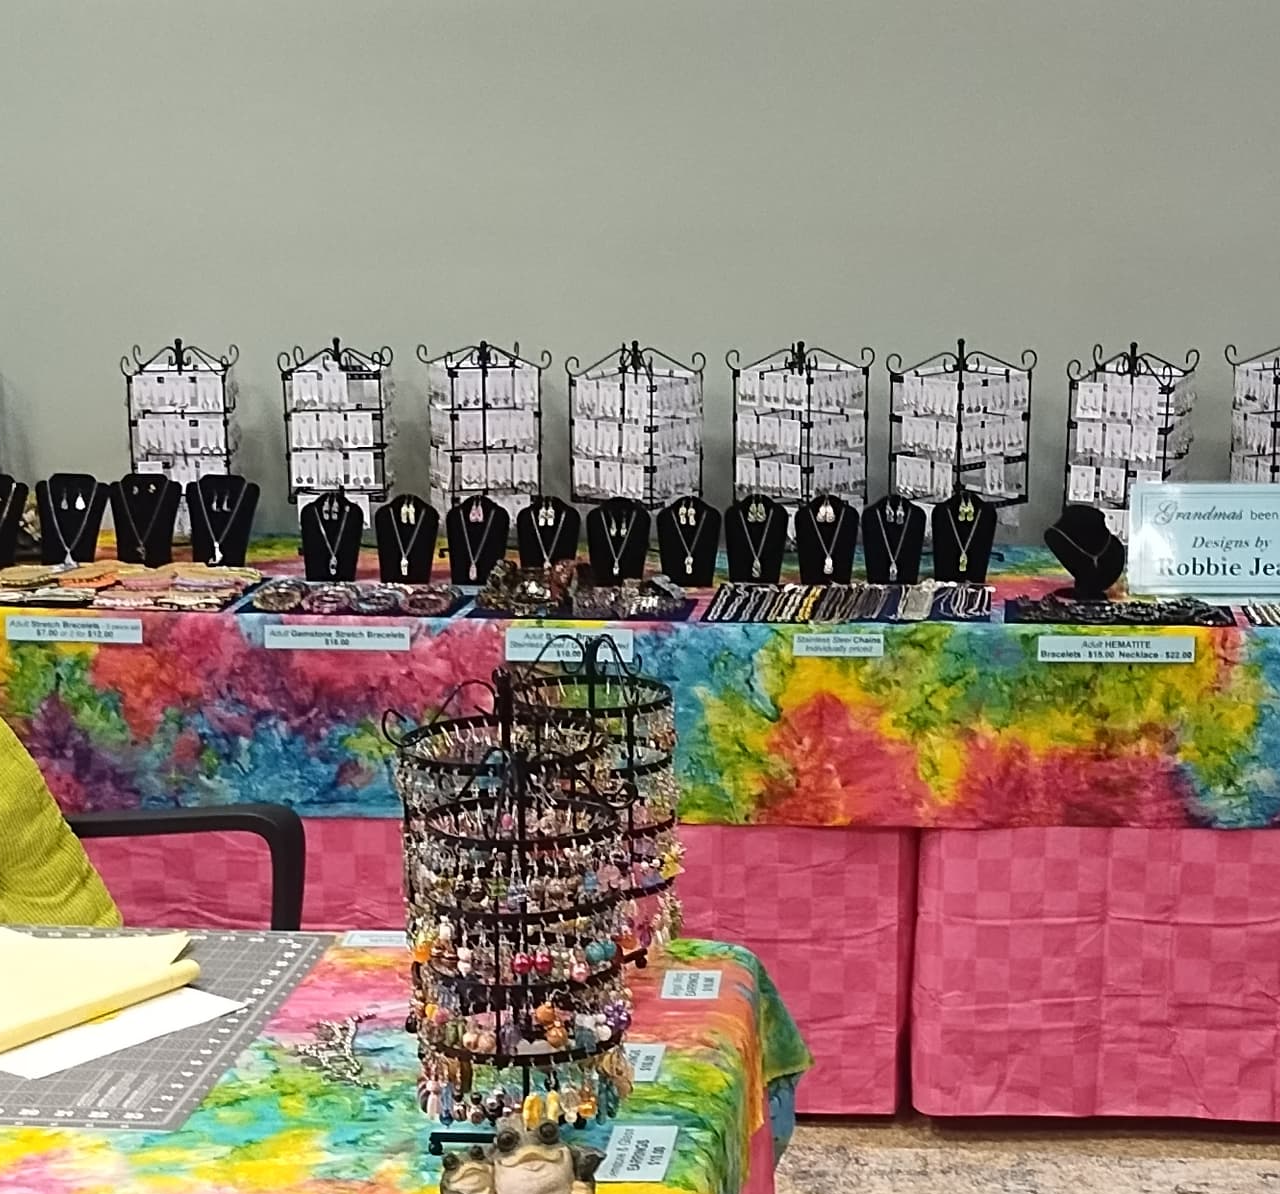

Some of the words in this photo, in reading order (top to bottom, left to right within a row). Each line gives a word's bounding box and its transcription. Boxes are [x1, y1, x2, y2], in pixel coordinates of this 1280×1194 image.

[1154, 500, 1243, 525] Grandmas
[1250, 510, 1279, 520] been
[1192, 536, 1250, 552] Designs
[1255, 536, 1272, 552] by
[1158, 556, 1242, 576] Robbie
[63, 621, 100, 629] Bracelets
[291, 630, 332, 638] Gemstone
[335, 630, 364, 638] Stretch
[367, 631, 406, 639] Bracelets
[1041, 650, 1081, 658] Bracelets
[1120, 651, 1159, 659] Necklace
